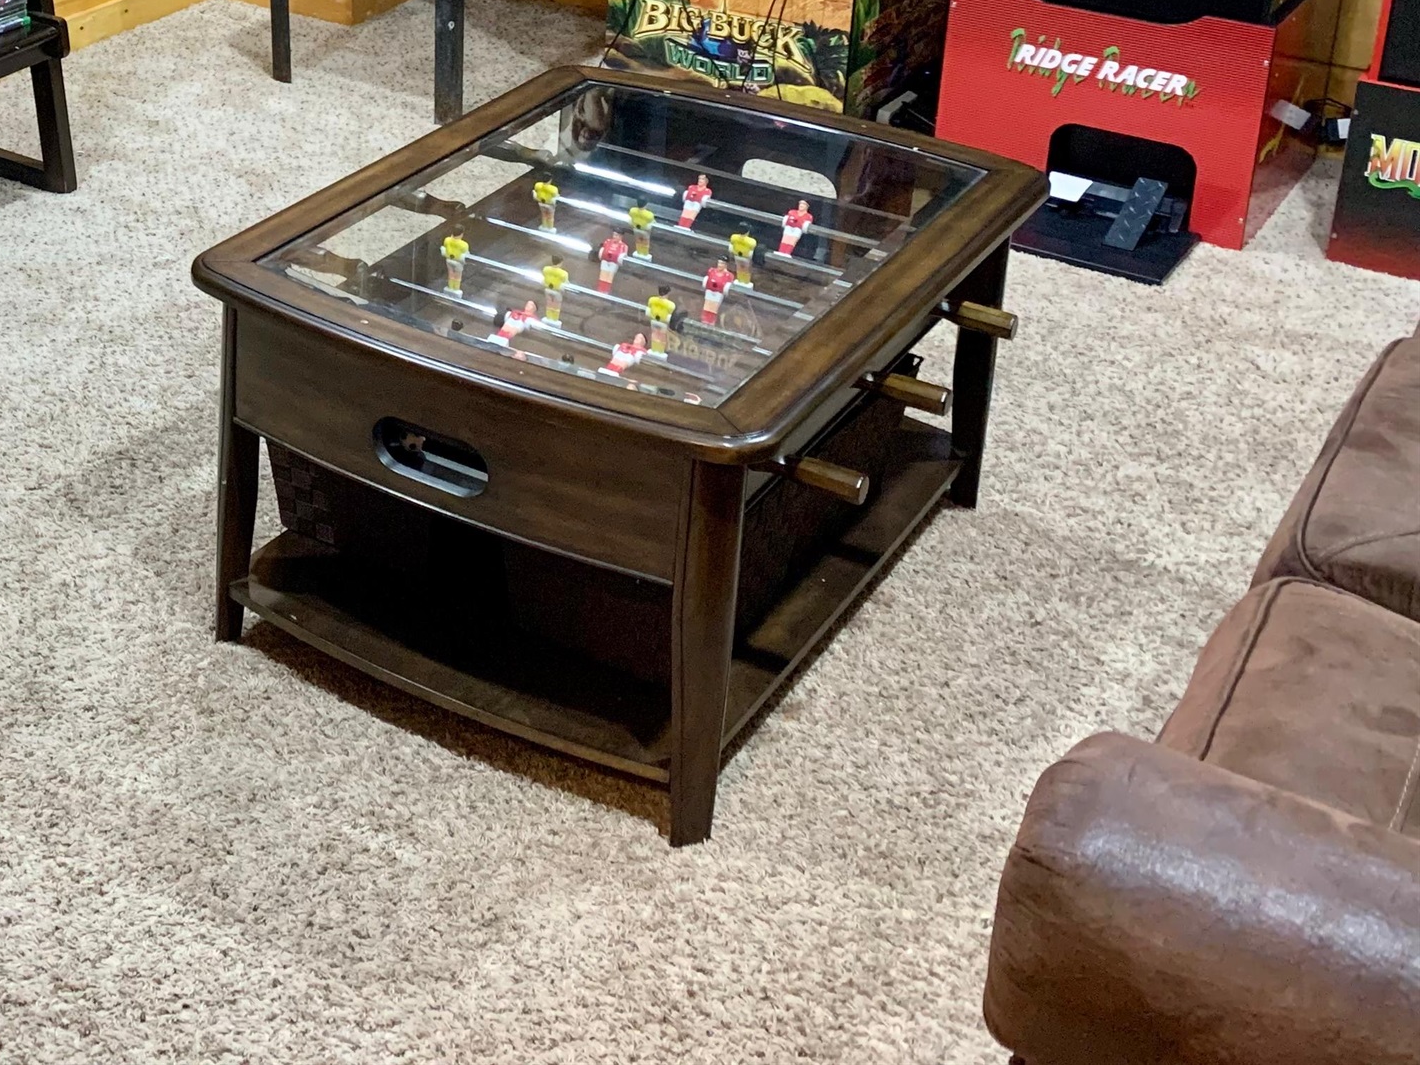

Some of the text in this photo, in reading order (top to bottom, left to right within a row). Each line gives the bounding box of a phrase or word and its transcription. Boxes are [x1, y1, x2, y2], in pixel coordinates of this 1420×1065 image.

[665, 37, 774, 84] WORLD
[708, 9, 814, 75] BUCK
[1096, 60, 1189, 96] RACER
